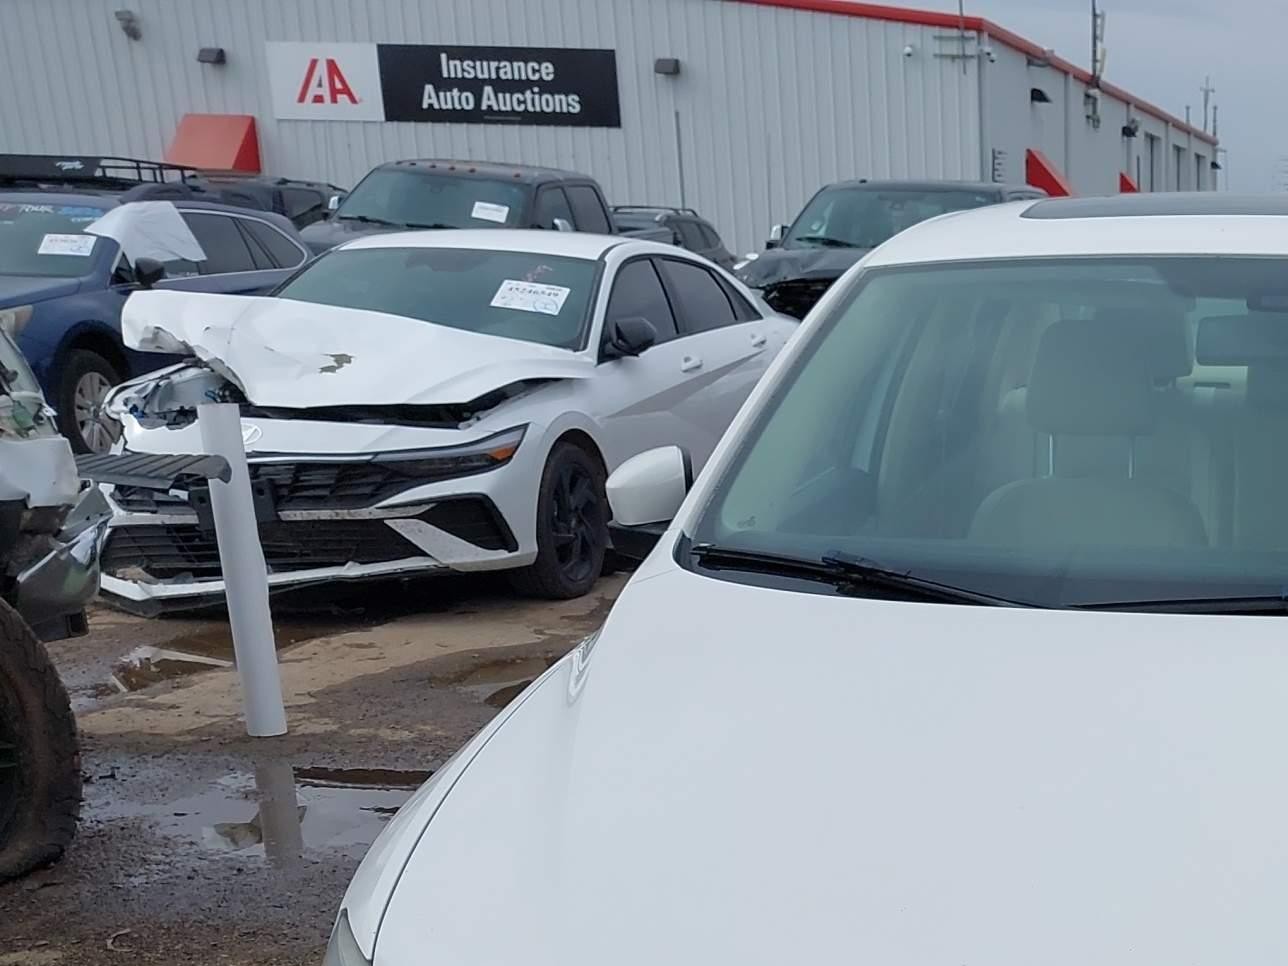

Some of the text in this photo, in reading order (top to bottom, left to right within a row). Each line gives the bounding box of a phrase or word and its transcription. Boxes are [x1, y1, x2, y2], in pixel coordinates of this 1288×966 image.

[439, 52, 555, 81] Insurance
[421, 84, 581, 114] Auto Auctions
